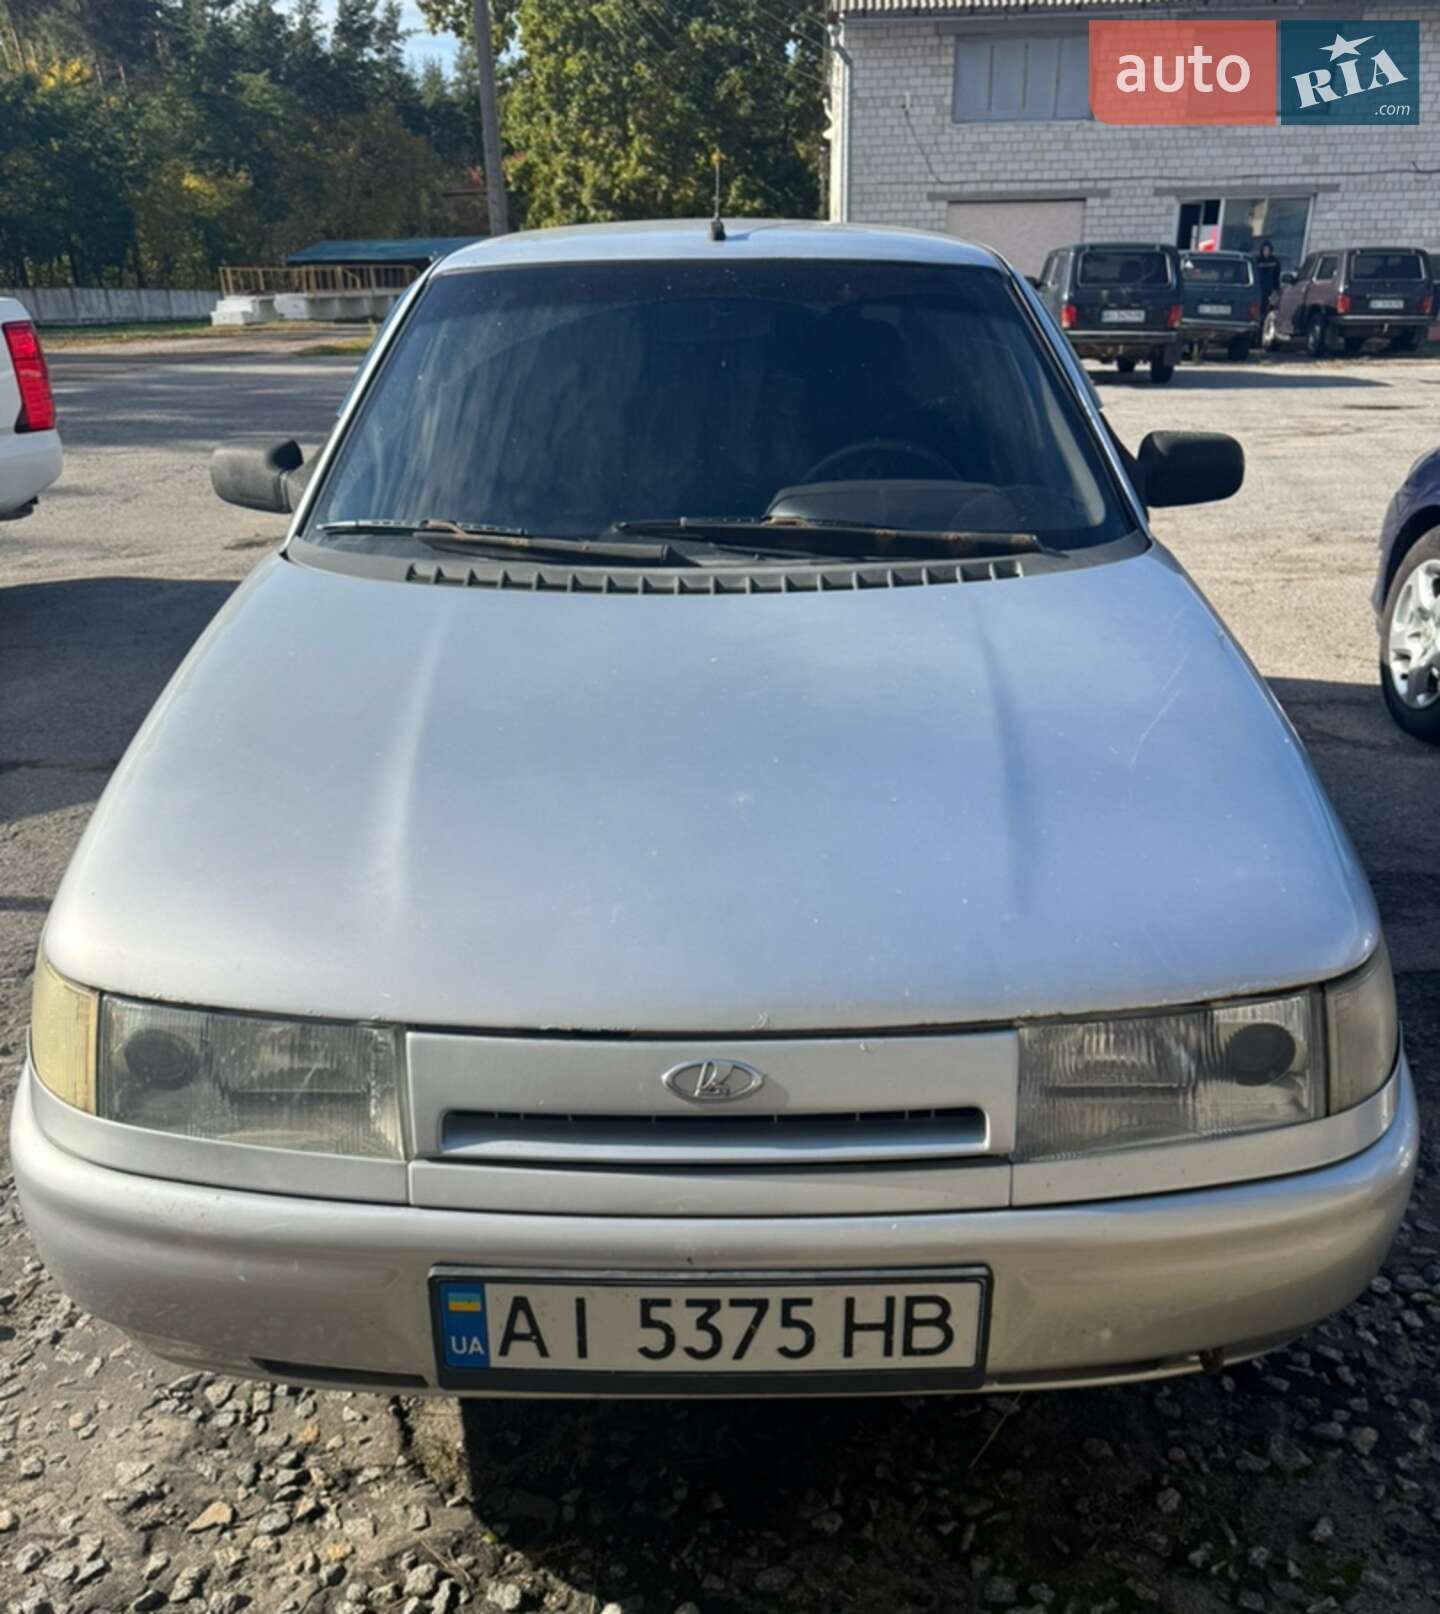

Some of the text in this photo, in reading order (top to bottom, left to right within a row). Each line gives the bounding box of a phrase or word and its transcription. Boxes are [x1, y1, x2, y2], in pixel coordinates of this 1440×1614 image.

[450, 1336, 486, 1356] UA
[498, 1295, 955, 1361] AI 5375 HB
